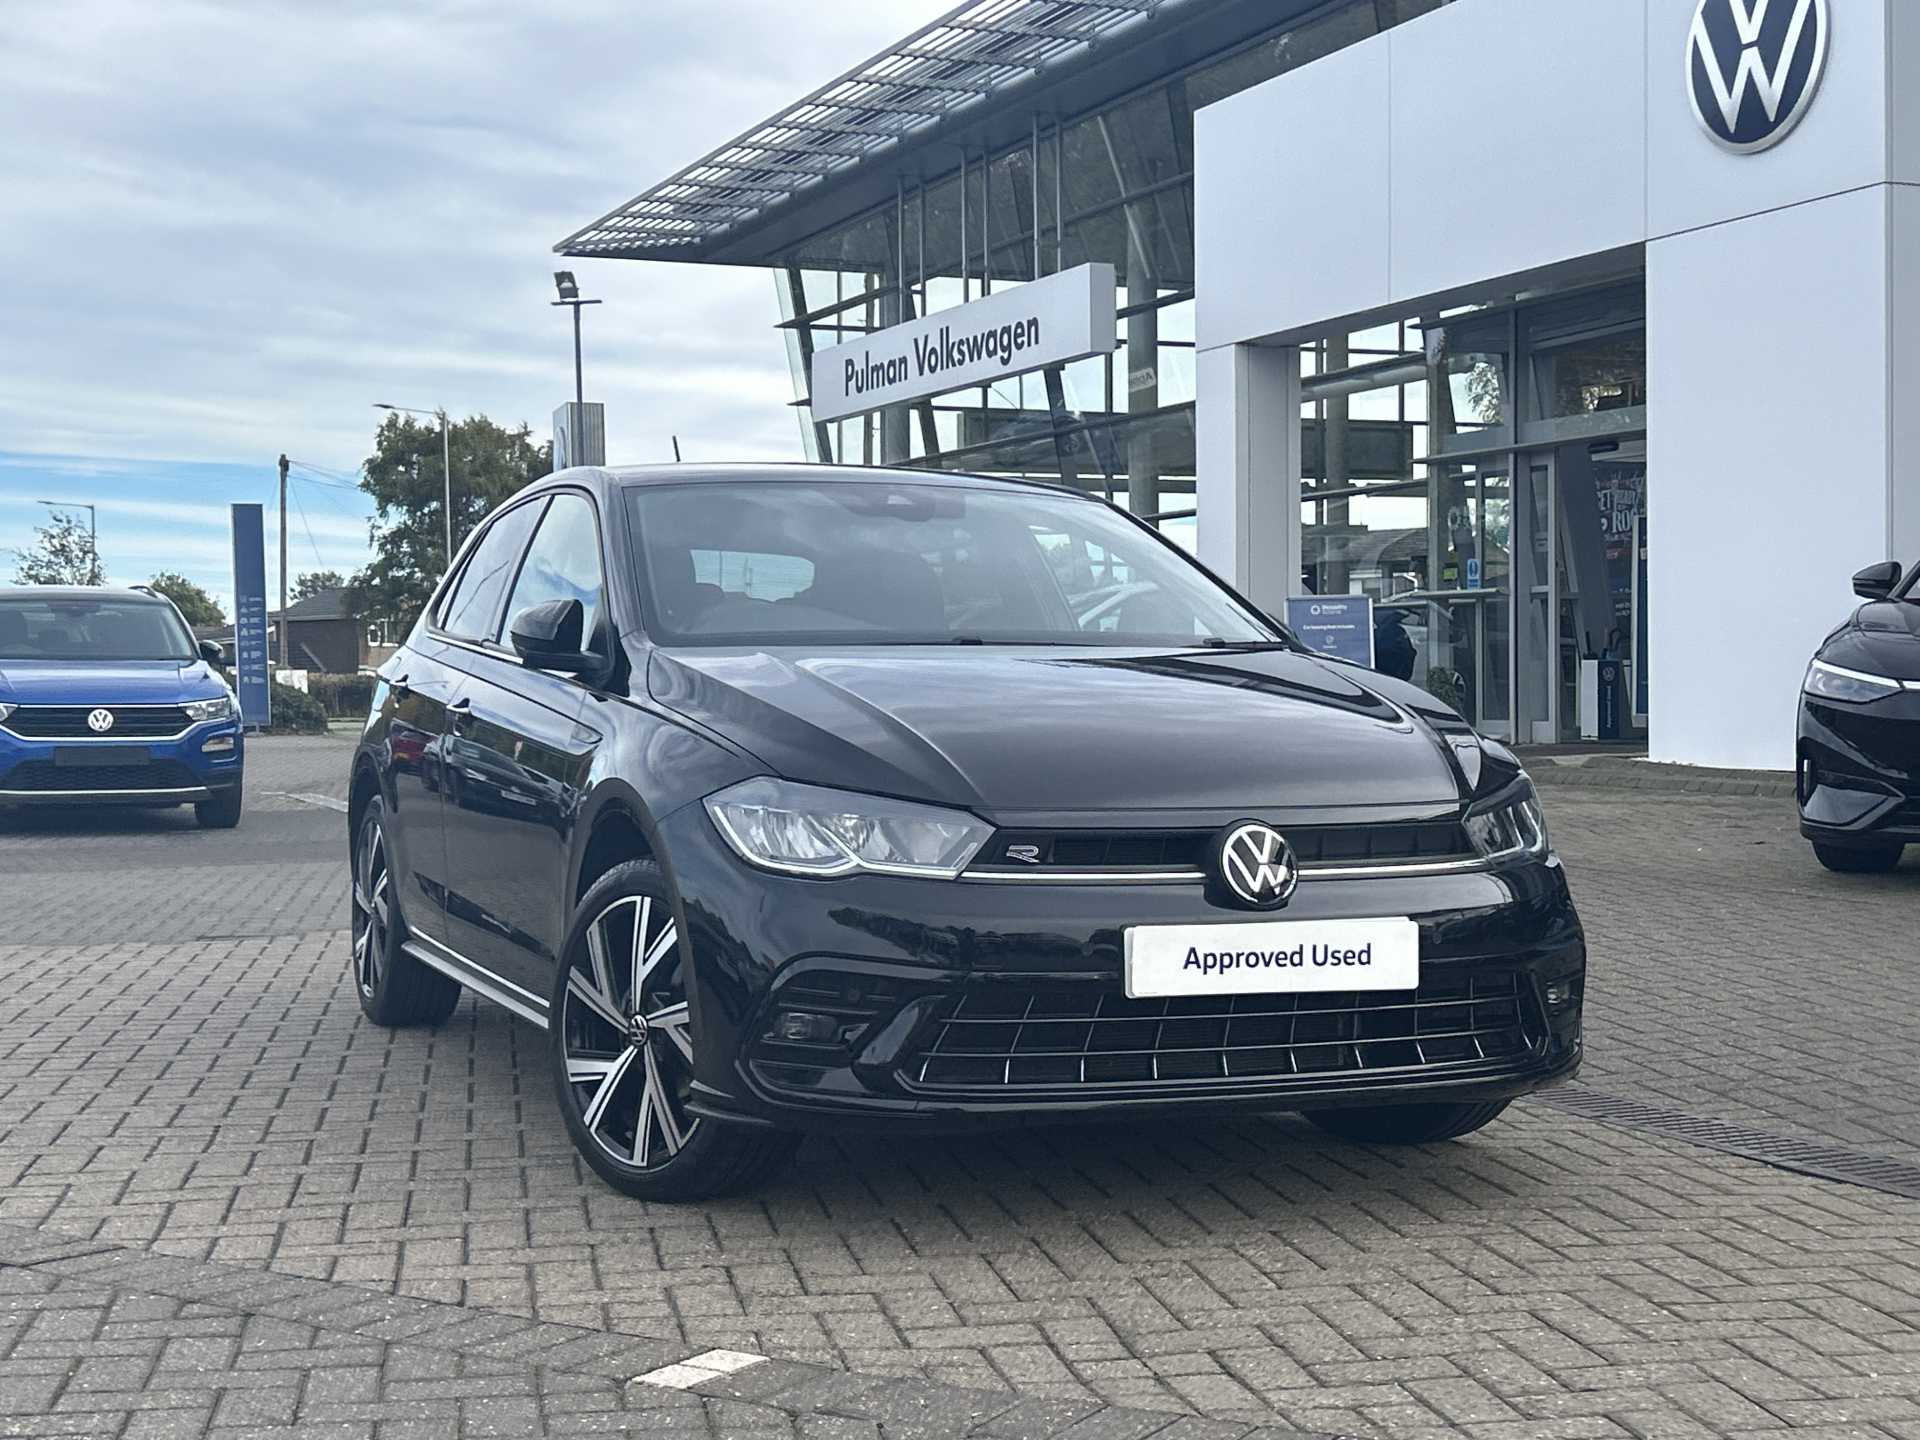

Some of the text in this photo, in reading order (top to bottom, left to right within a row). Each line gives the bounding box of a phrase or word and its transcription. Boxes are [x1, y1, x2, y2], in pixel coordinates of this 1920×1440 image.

[844, 316, 1040, 396] Pulman Volkswagen
[1223, 825, 1296, 903] VW
[1183, 942, 1372, 975] Approved Used
